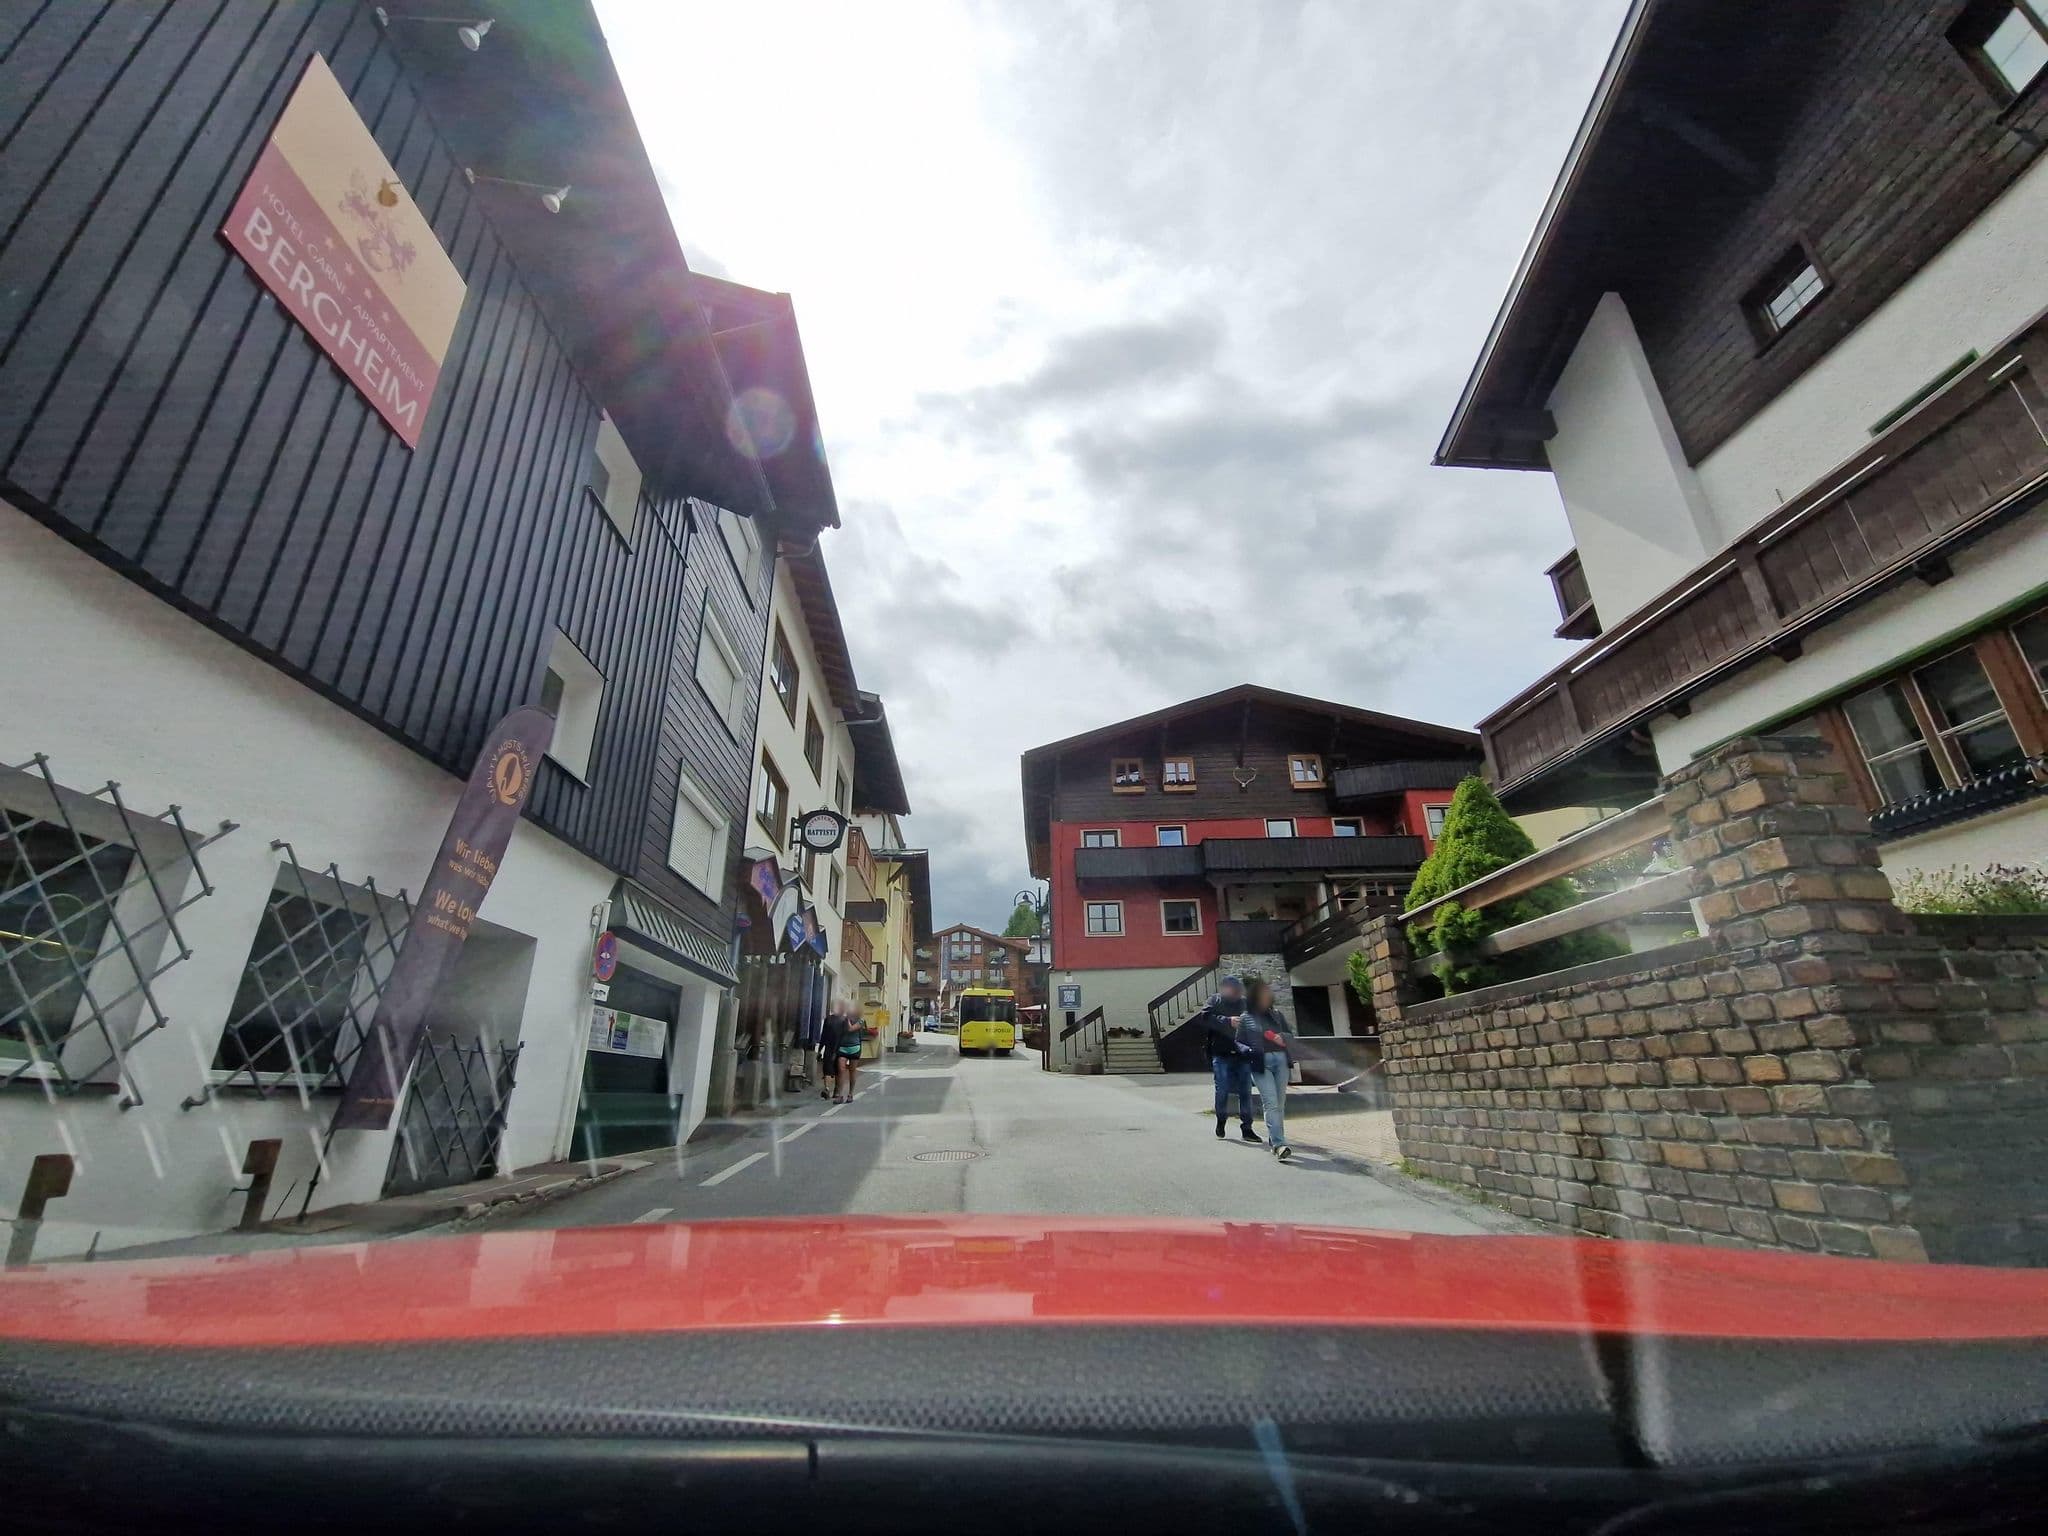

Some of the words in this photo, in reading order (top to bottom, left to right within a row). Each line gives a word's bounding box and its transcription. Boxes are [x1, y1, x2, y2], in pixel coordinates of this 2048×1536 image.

[263, 185, 303, 246] HOTEL
[307, 243, 346, 295] GARNI
[244, 207, 418, 428] BERGHEIM
[456, 839, 471, 858] Wir
[435, 889, 456, 914] We
[427, 914, 449, 931] what
